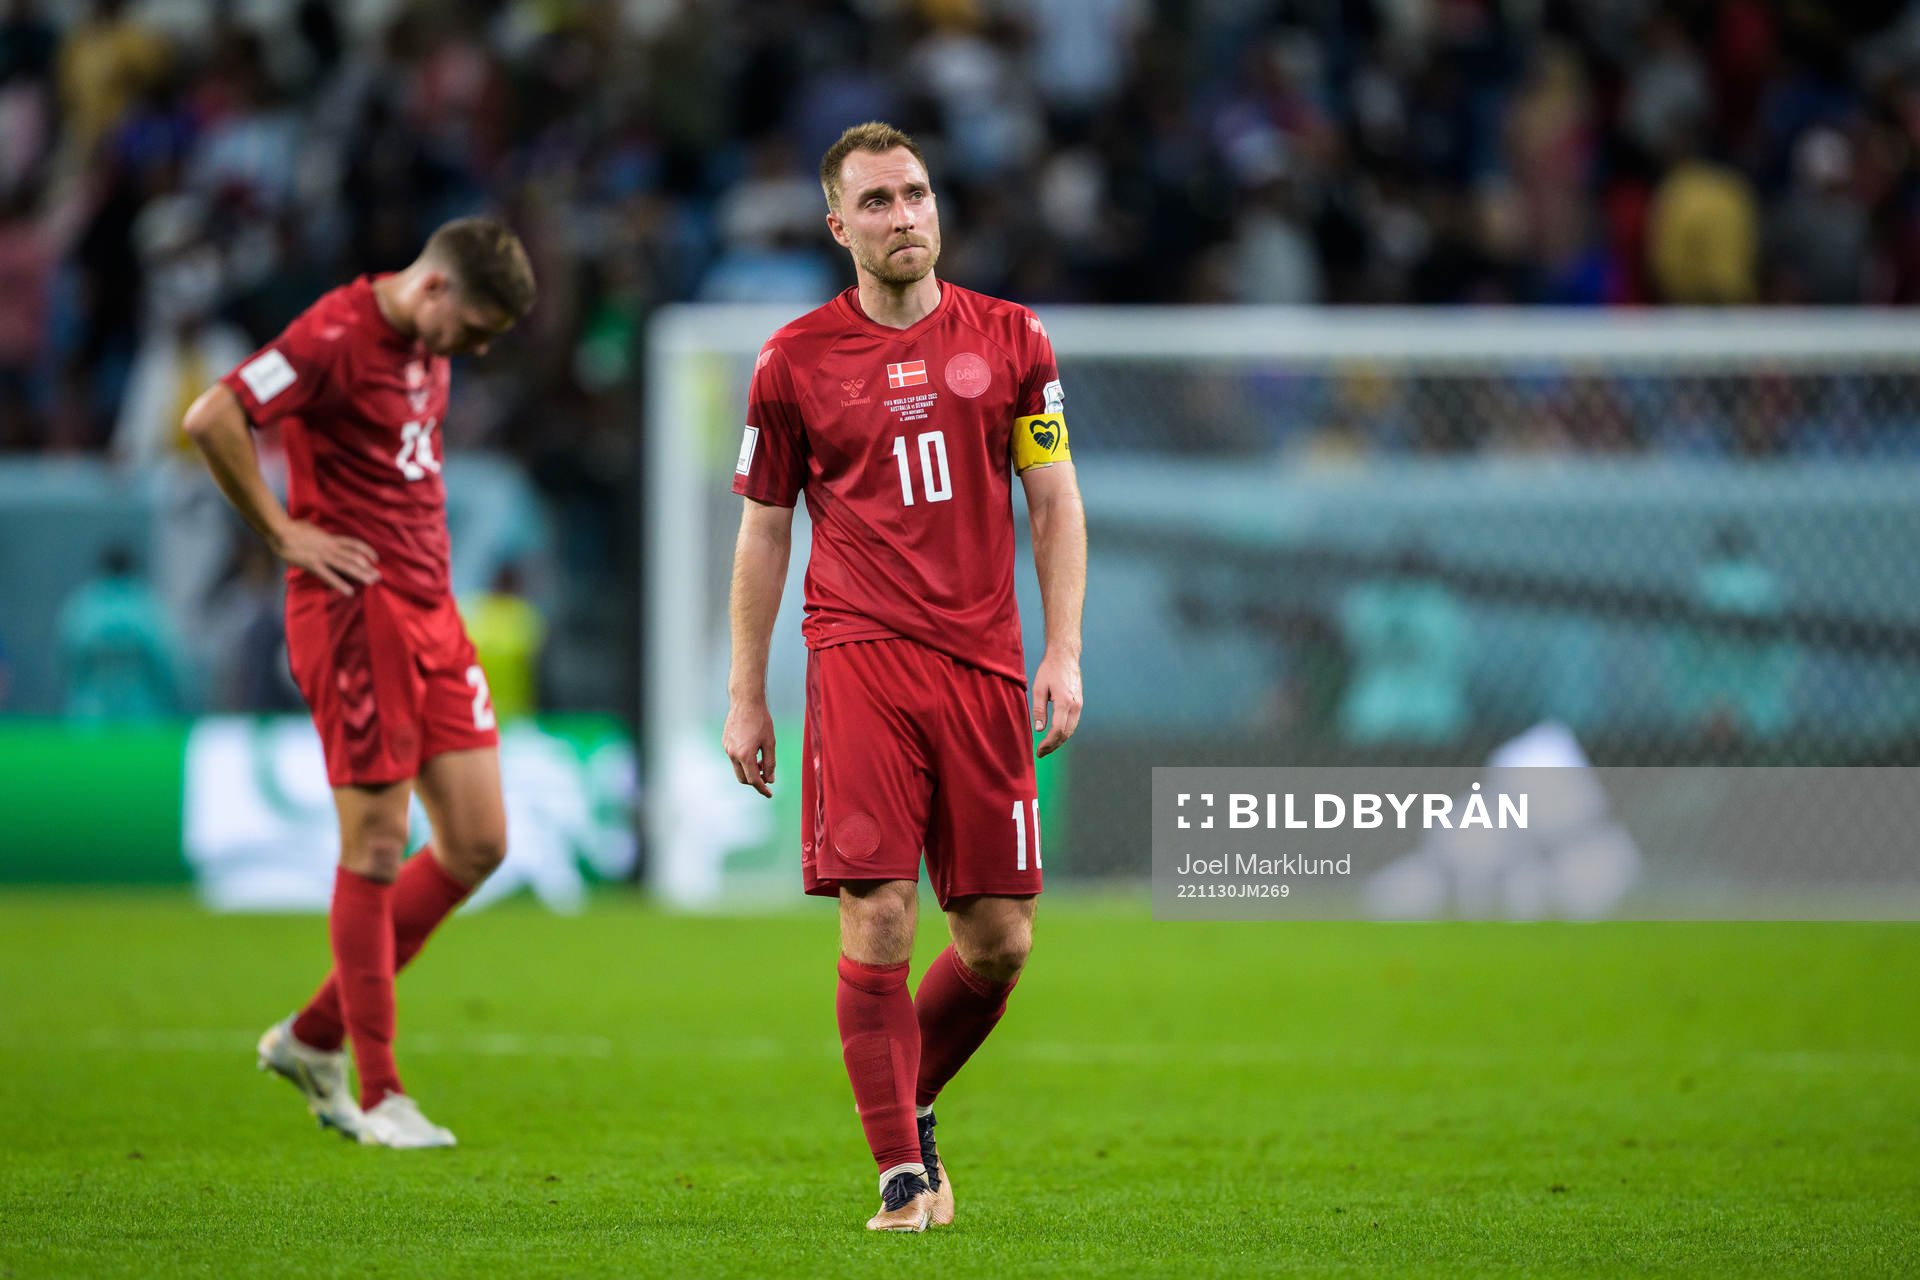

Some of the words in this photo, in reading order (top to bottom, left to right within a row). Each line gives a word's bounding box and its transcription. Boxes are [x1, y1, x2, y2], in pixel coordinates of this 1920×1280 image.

[840, 396, 871, 408] hummel
[890, 404, 911, 412] AUSTRALIA
[892, 430, 953, 507] 10
